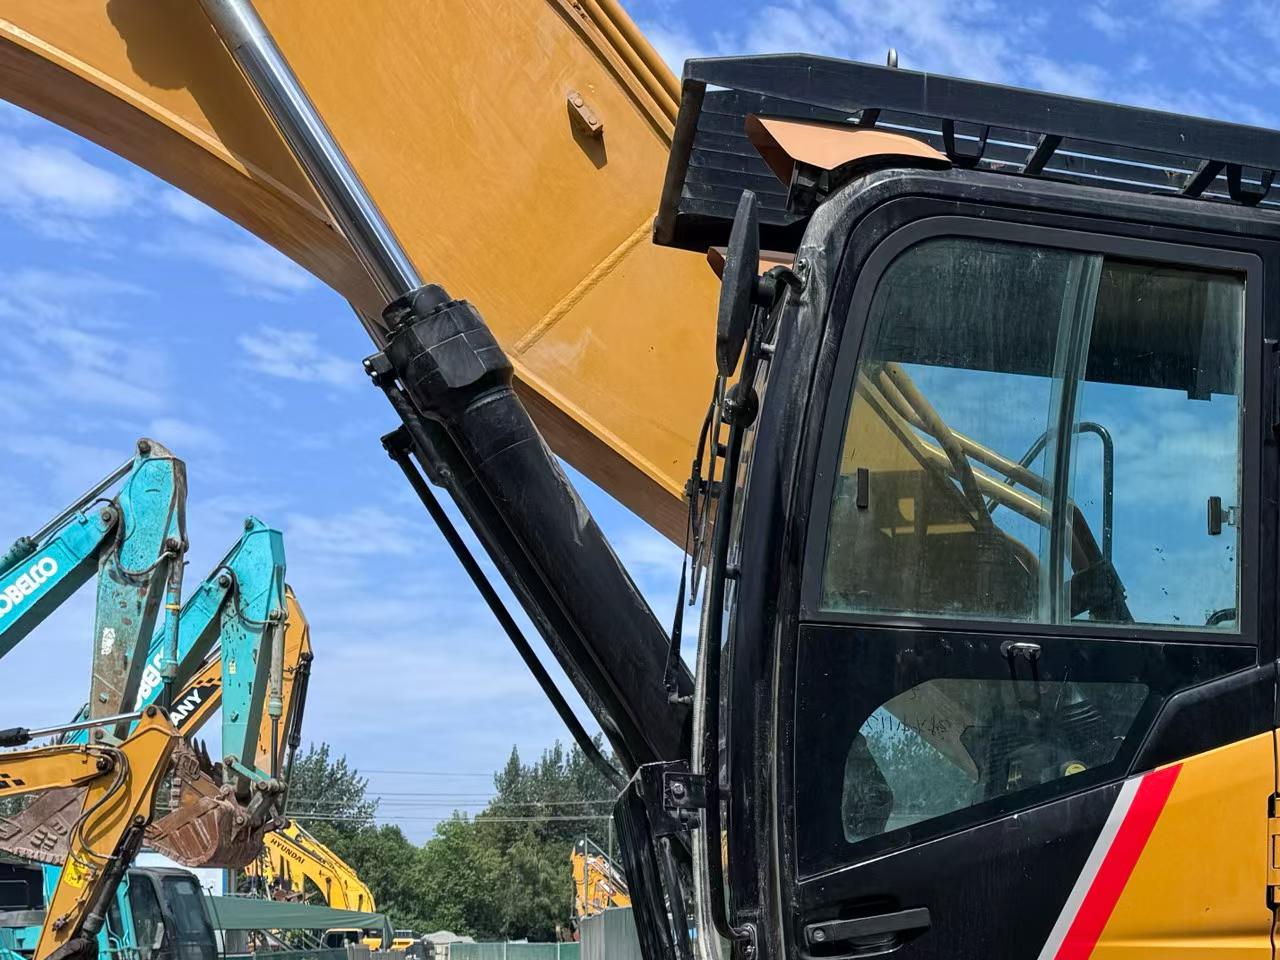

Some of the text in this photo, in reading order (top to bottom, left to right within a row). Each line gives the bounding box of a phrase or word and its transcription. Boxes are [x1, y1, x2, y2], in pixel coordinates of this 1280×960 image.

[0, 557, 58, 619] OBELCO
[170, 689, 202, 727] ANY
[271, 838, 306, 864] HYUNDAI
